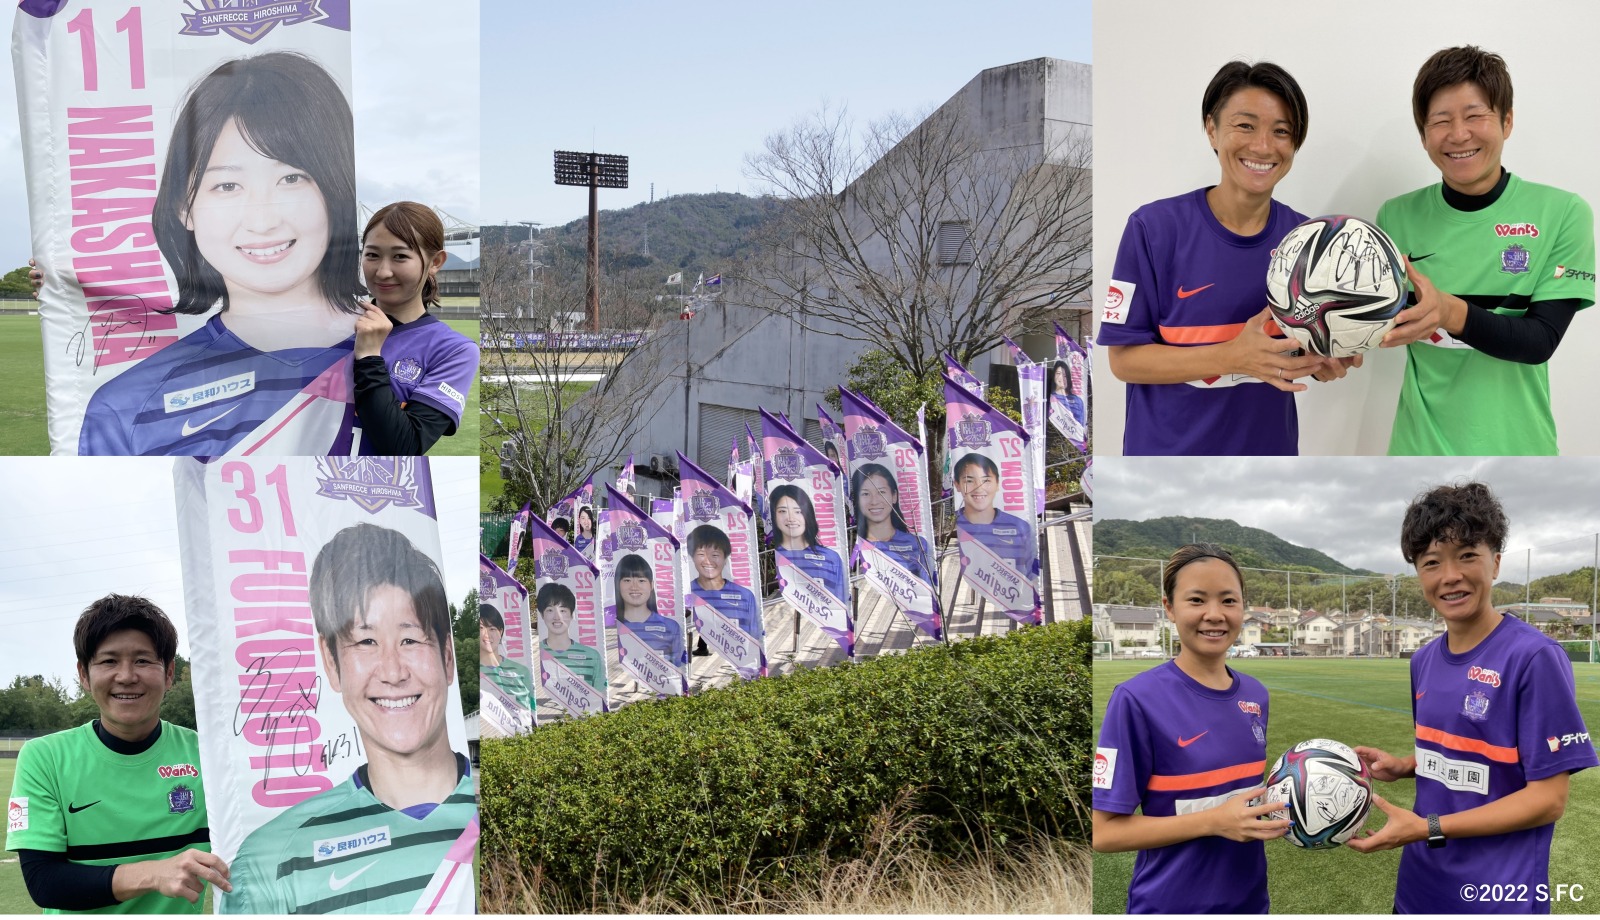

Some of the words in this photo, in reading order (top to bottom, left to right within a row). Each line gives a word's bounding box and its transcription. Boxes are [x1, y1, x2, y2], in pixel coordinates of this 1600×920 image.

[202, 12, 248, 25] SANFRECCE
[253, 4, 298, 20] HIROSHIMA
[67, 6, 146, 92] 11
[67, 104, 180, 368] NAKASHIMA
[1494, 222, 1539, 238] Wants
[1294, 303, 1320, 321] adidas
[221, 461, 298, 537] 31
[333, 482, 368, 494] SANFRECCE
[371, 487, 403, 498] HIROSHIMA
[229, 549, 335, 809] FUKUMOTO
[158, 764, 199, 779] Wants
[337, 832, 387, 852] 良和ハウス
